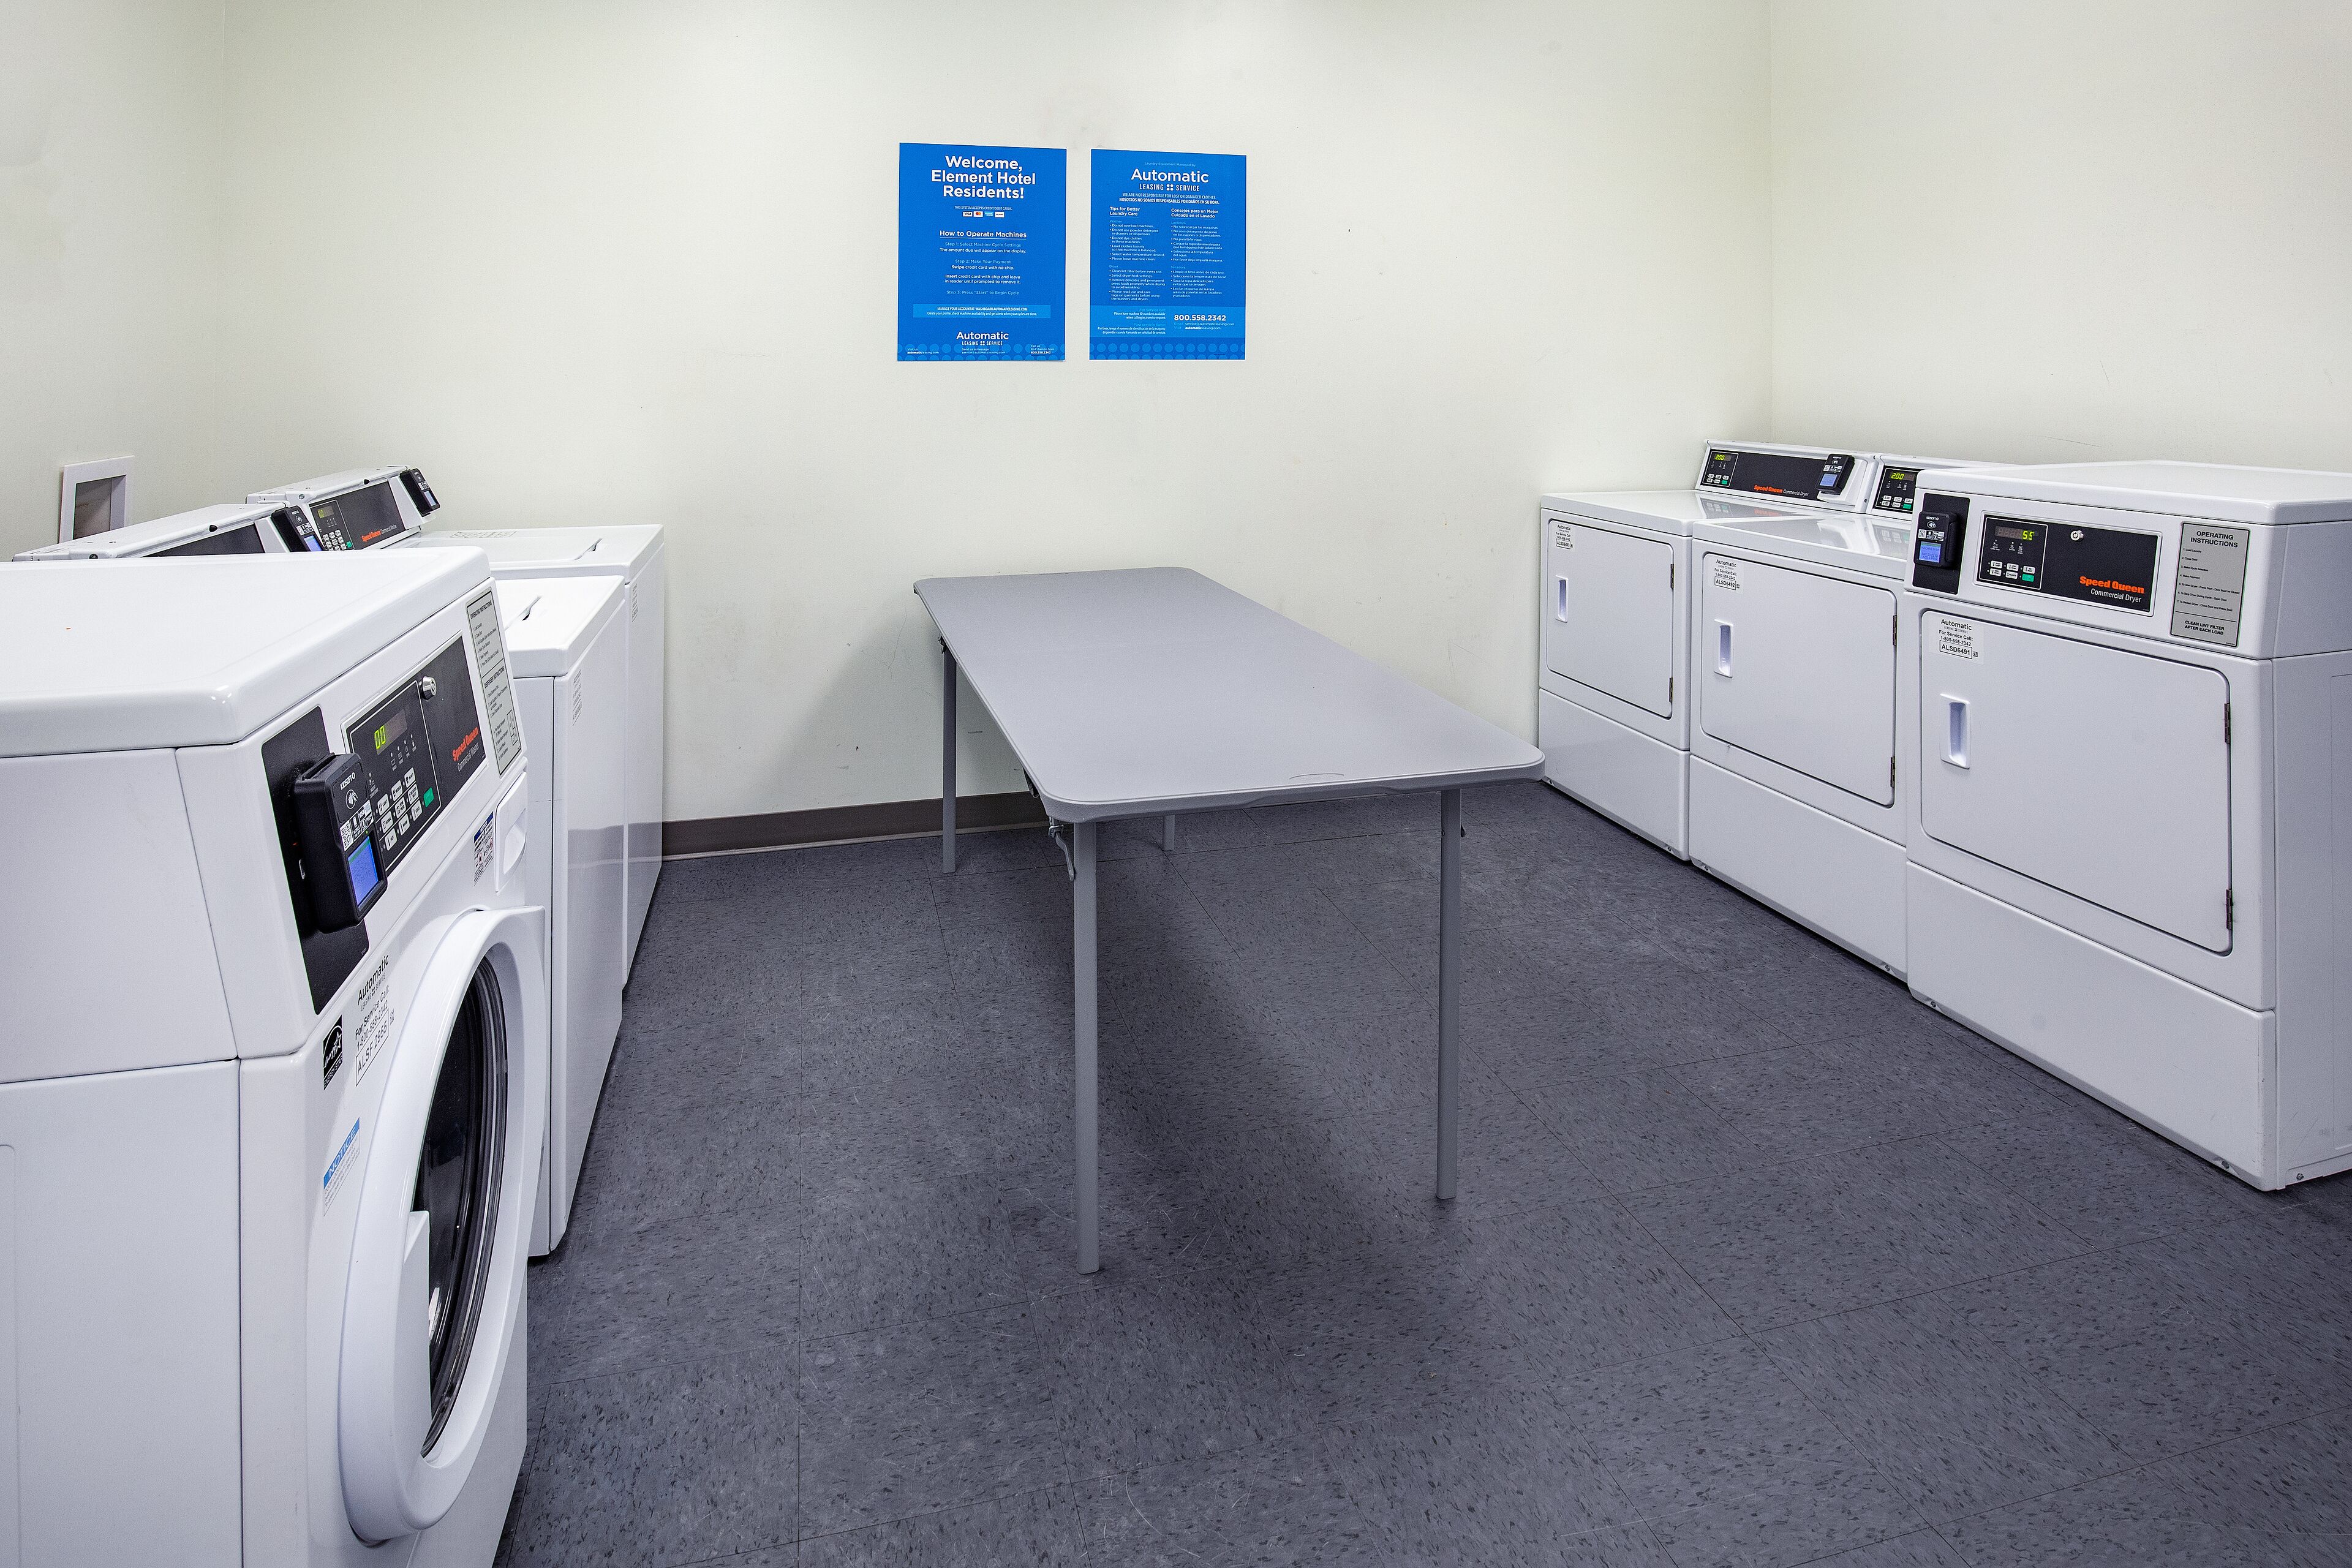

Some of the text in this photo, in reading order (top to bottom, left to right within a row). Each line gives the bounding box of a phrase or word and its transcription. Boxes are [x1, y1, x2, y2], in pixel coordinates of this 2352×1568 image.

[944, 155, 1022, 172] Welcome,
[931, 169, 1035, 185] Element Hotel
[1131, 168, 1208, 183] Automatic
[943, 184, 1023, 198] Residents!
[956, 331, 1009, 339] Automatic
[2190, 537, 2238, 548] INSTRUCTIONS
[2196, 530, 2234, 540] OPERATING
[2079, 576, 2145, 594] Speed Queen
[2090, 589, 2142, 603] Commercial Dryer
[1941, 619, 1972, 630] Automatic
[1940, 636, 1972, 646] 1-800-558-2342
[1942, 644, 1970, 655] ALSD6491
[453, 726, 478, 761] Speed Queen
[458, 750, 472, 772] Commercial
[358, 954, 389, 1006] Automatic
[355, 1023, 364, 1041] For
[364, 1000, 380, 1027] Service
[357, 1020, 387, 1076] ALSF 2955
[328, 1128, 356, 1176] NOTICE
